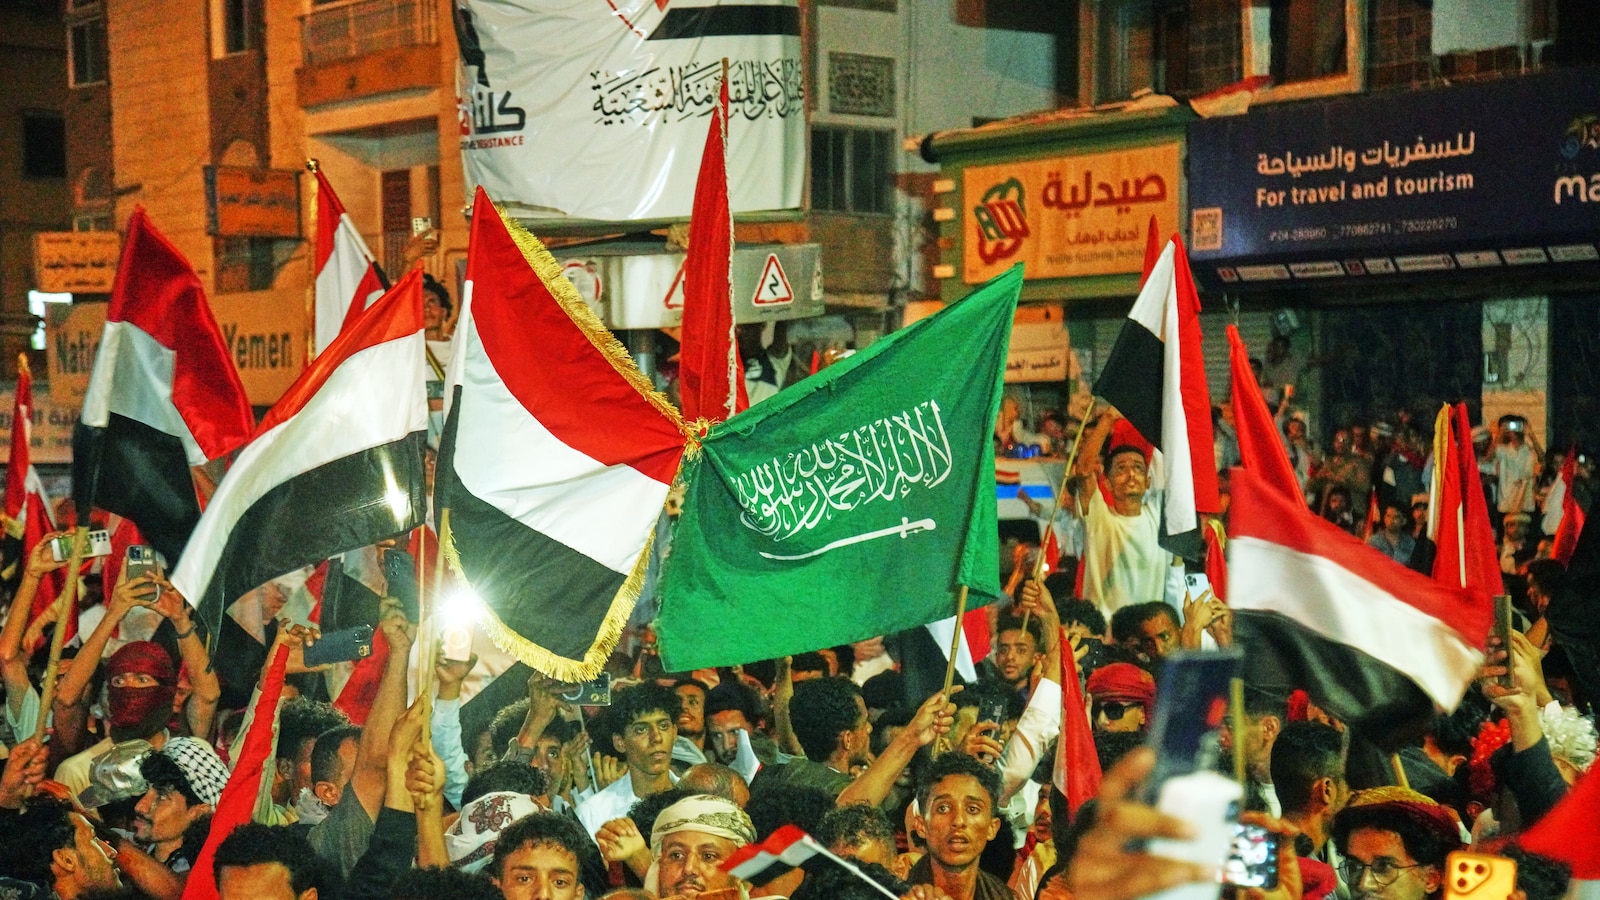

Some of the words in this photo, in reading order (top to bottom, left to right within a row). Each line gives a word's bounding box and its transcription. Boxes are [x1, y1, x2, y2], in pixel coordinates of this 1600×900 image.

[1256, 145, 1357, 178] والسياحة
[1361, 131, 1476, 168] للسفريات
[1042, 169, 1167, 219] صيدلية
[1256, 187, 1285, 209] For
[1291, 180, 1346, 206] travel
[1352, 176, 1389, 200] and
[1395, 170, 1474, 195] tourism
[222, 322, 293, 370] Yemen
